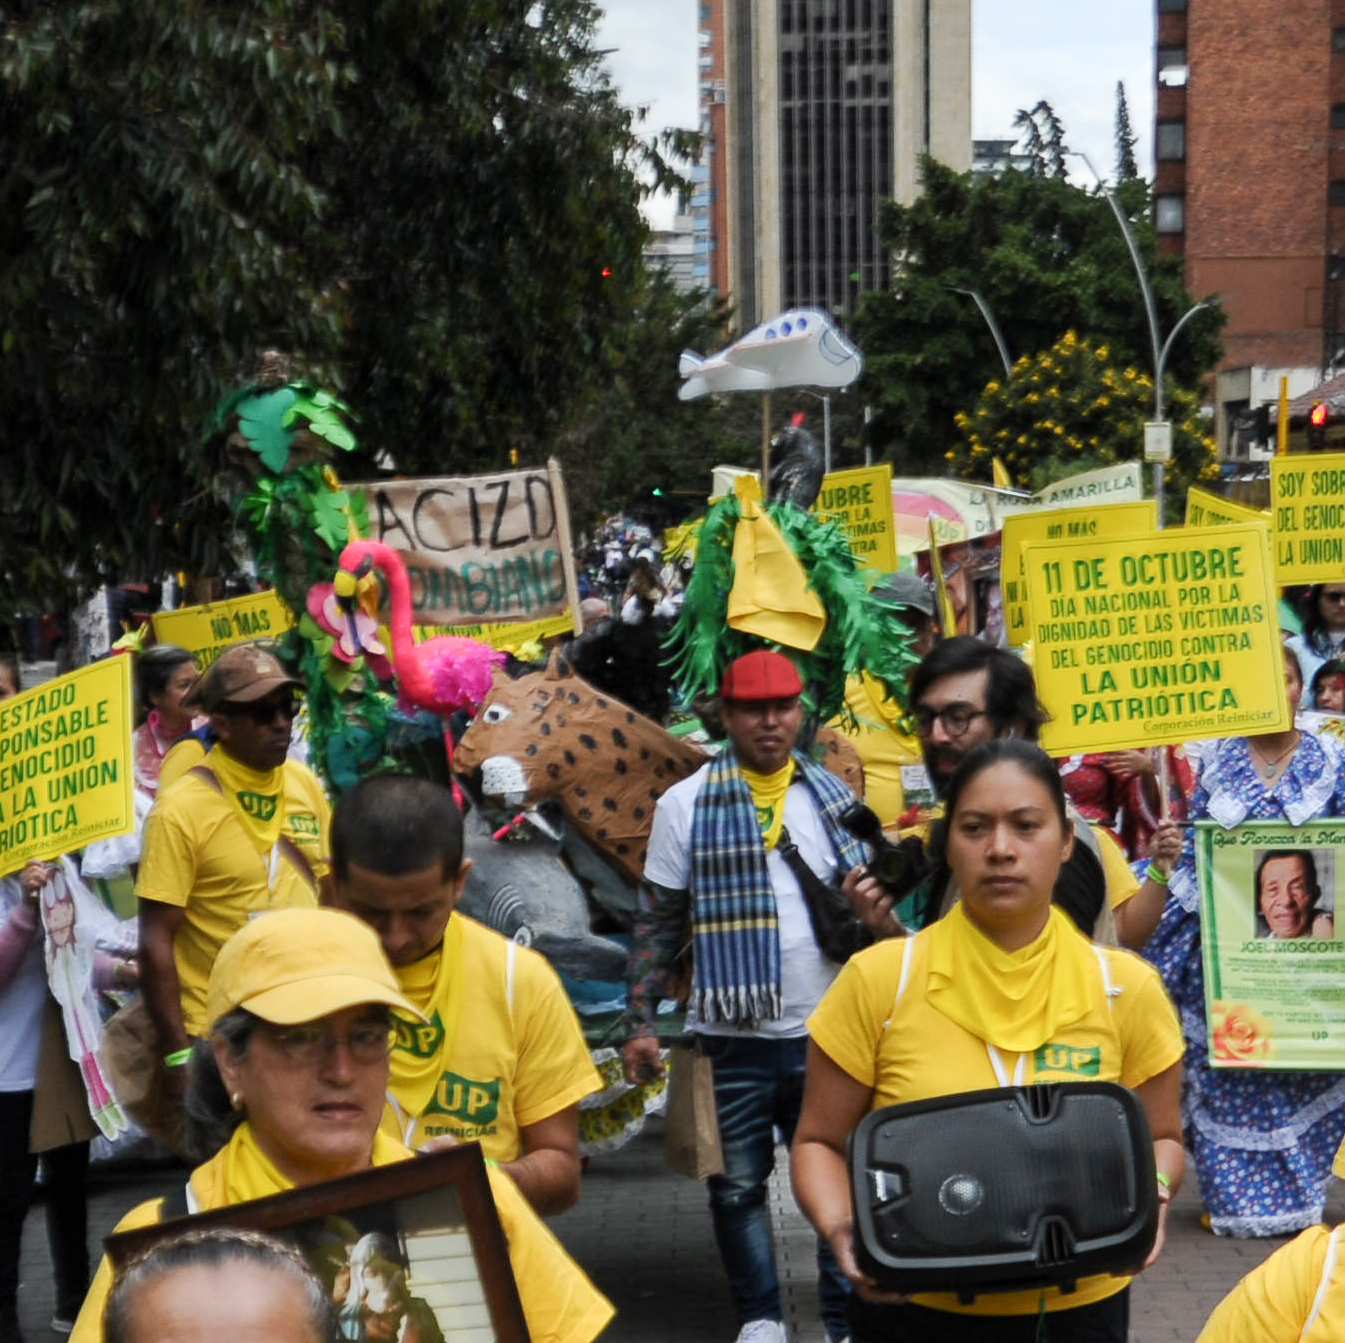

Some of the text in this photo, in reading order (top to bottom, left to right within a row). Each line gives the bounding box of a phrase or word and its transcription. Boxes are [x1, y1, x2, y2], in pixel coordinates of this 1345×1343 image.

[814, 483, 873, 512] UBRE
[1048, 476, 1135, 503] AMARILLA
[1279, 472, 1305, 497] SOY
[839, 521, 885, 537] TIMAS
[1278, 507, 1298, 532] DEL
[1279, 541, 1293, 566] LA
[1299, 534, 1343, 564] UNIÓN
[1042, 562, 1063, 593] 11
[1073, 558, 1107, 590] DE
[1119, 546, 1244, 586] OCTUBRE
[1050, 584, 1241, 618] DÍA NACIONAL POR LA
[211, 615, 232, 641] NO
[1038, 604, 1264, 644] DIGNIDAD DE LAS VÍCTIMAS
[1051, 632, 1252, 669] DEL GENOCIDIO CONTRA
[1080, 659, 1222, 695] LA UNIÓN
[0, 683, 76, 735] ESTADO
[1071, 685, 1239, 725] PATRIÓTICA
[12, 787, 37, 817] LA
[48, 759, 118, 802] UNIÓN
[1213, 831, 1237, 848] Que
[1273, 941, 1344, 953] MOSCOTE
[1312, 1031, 1328, 1040] UP
[1045, 1049, 1092, 1070] UP
[437, 1079, 491, 1116] UP
[424, 1125, 497, 1138] REINICIAR
